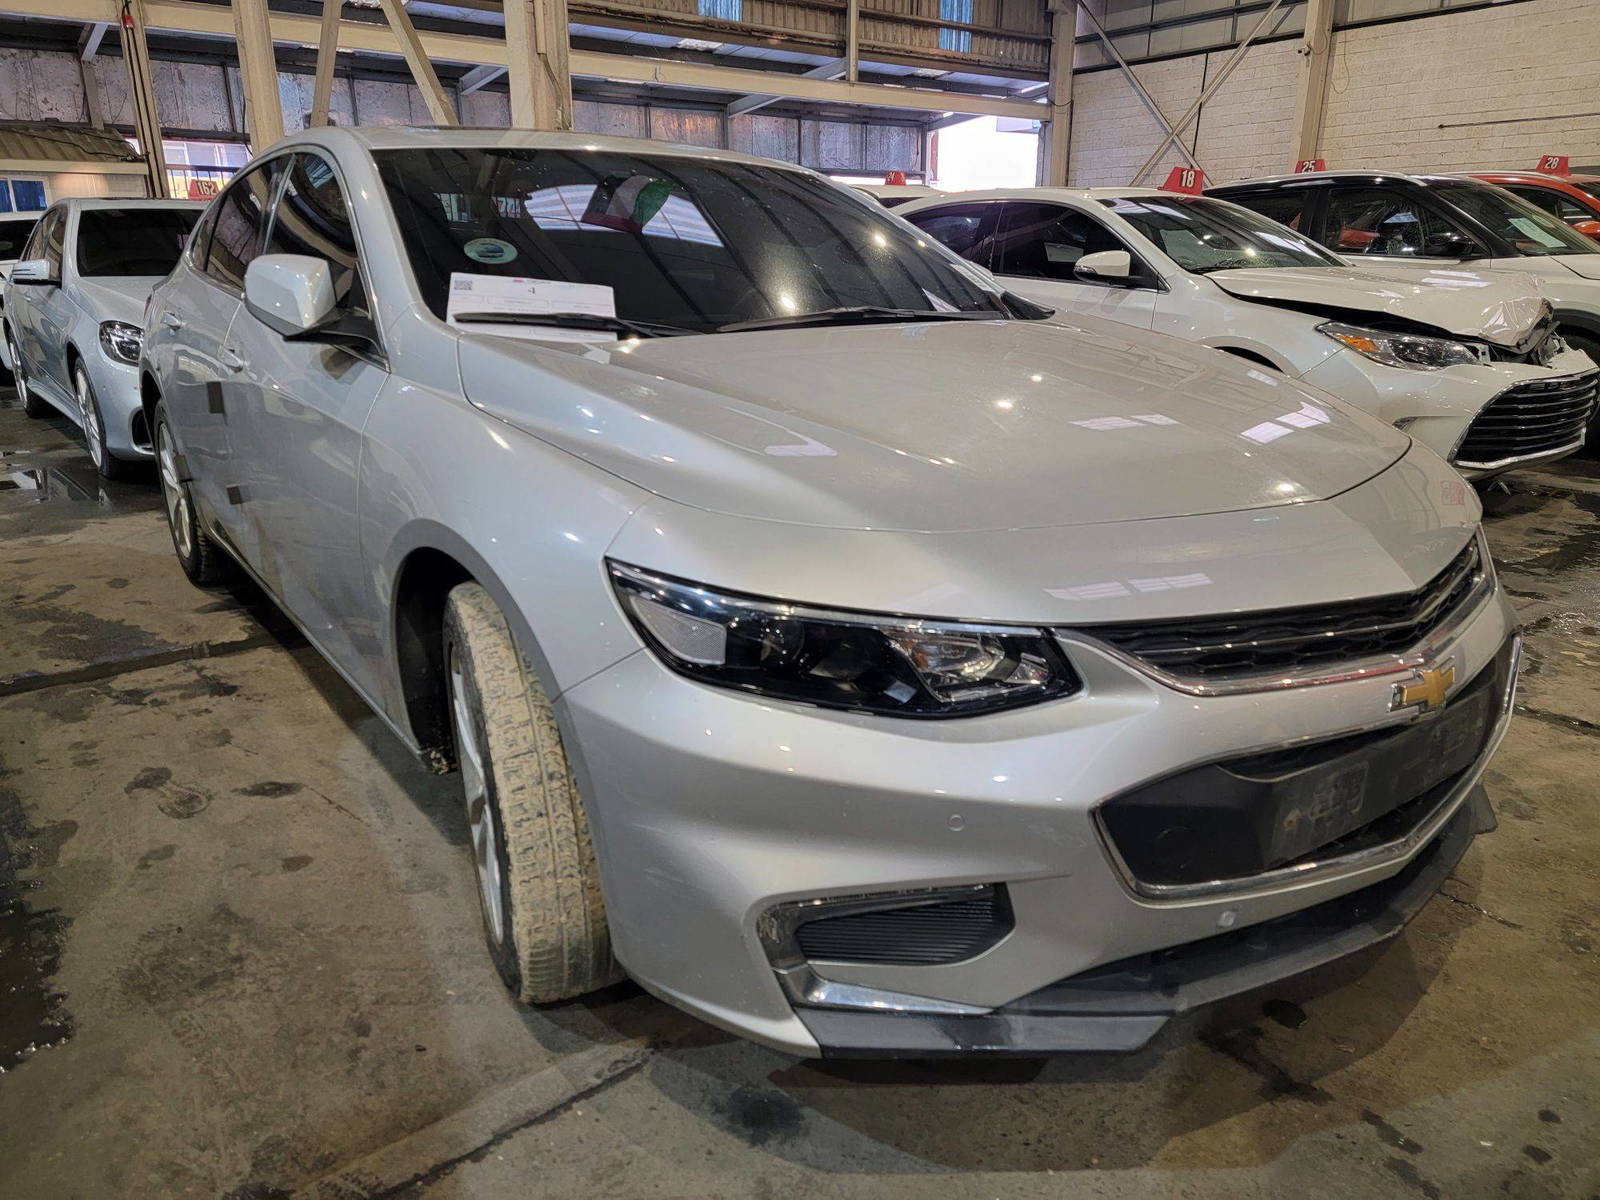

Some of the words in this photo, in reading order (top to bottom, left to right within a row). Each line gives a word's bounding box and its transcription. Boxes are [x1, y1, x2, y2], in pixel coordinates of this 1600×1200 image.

[1544, 156, 1560, 170] 28
[1181, 169, 1196, 188] 18
[198, 181, 217, 196] 162
